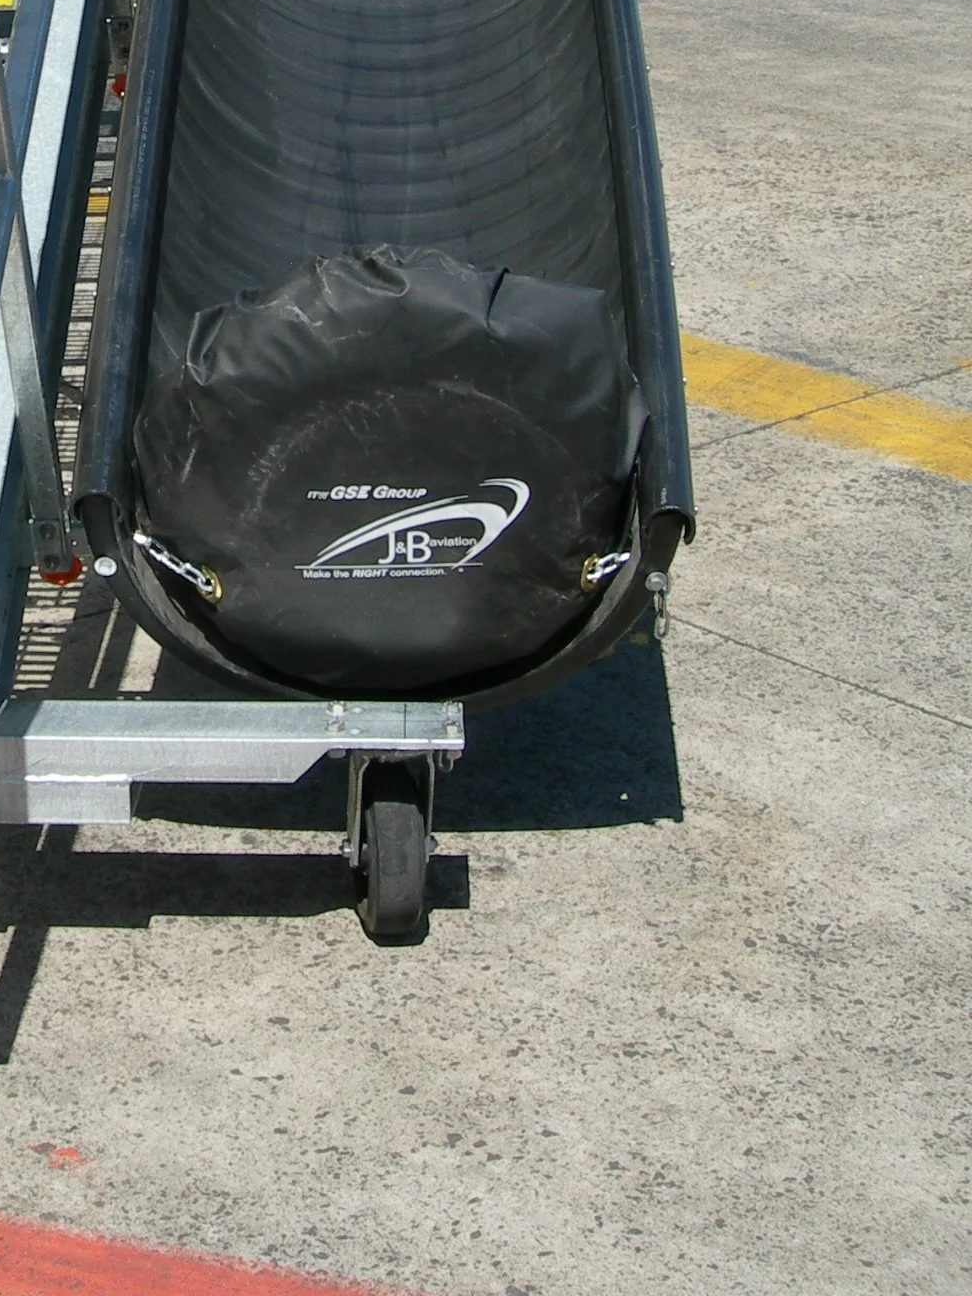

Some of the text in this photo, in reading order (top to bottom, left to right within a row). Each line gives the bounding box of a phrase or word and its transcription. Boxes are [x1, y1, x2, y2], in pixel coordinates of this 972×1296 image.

[330, 485, 372, 500] GSE
[378, 530, 477, 564] J&B aviation
[303, 567, 447, 579] Make the RIGHT connection.
